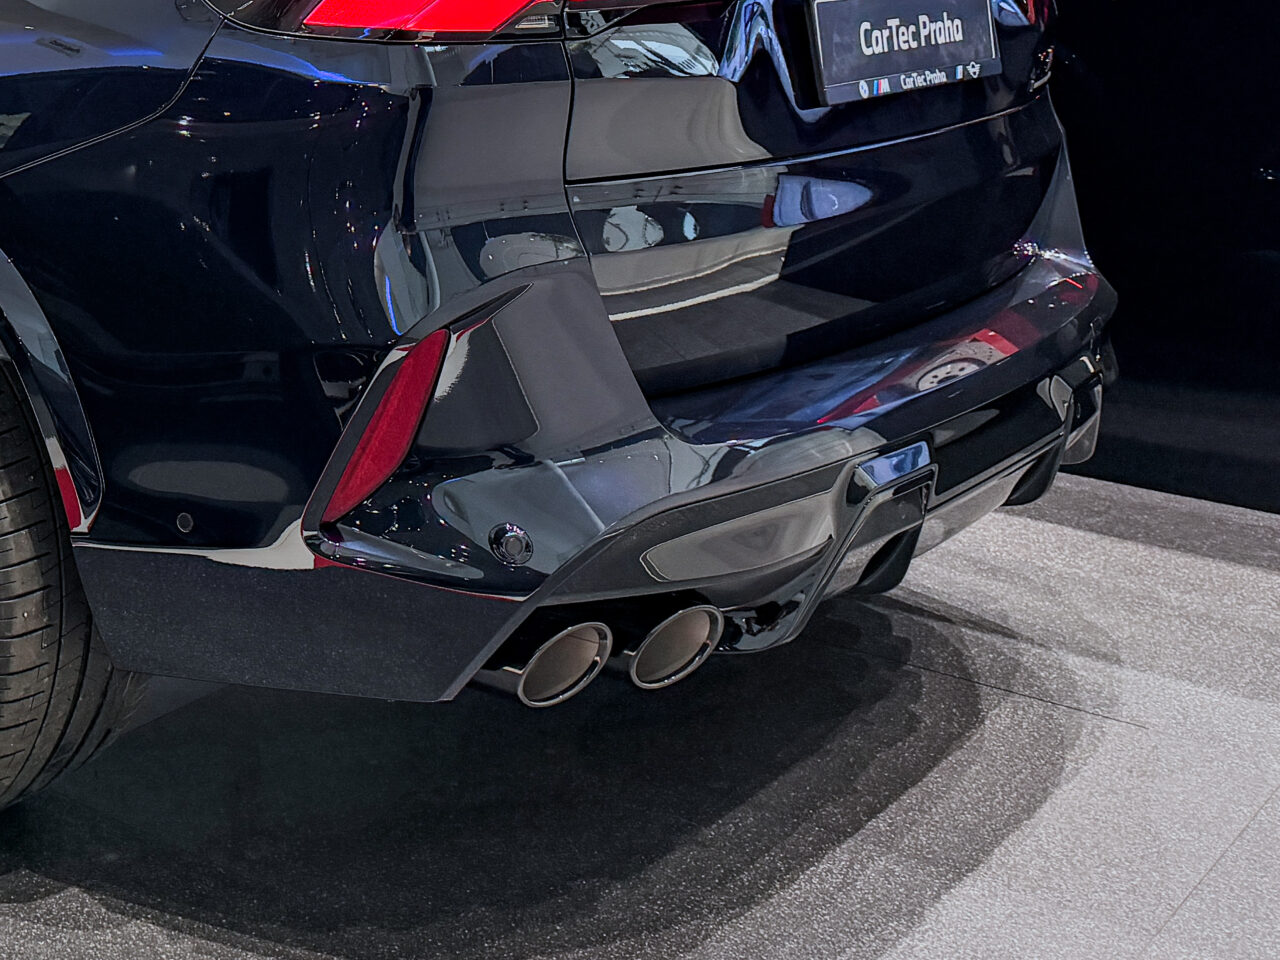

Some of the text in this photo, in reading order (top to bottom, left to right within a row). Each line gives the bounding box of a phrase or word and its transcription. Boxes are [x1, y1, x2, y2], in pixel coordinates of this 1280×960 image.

[860, 11, 964, 56] CarTec Praha
[900, 68, 948, 90] CarTec Praha
